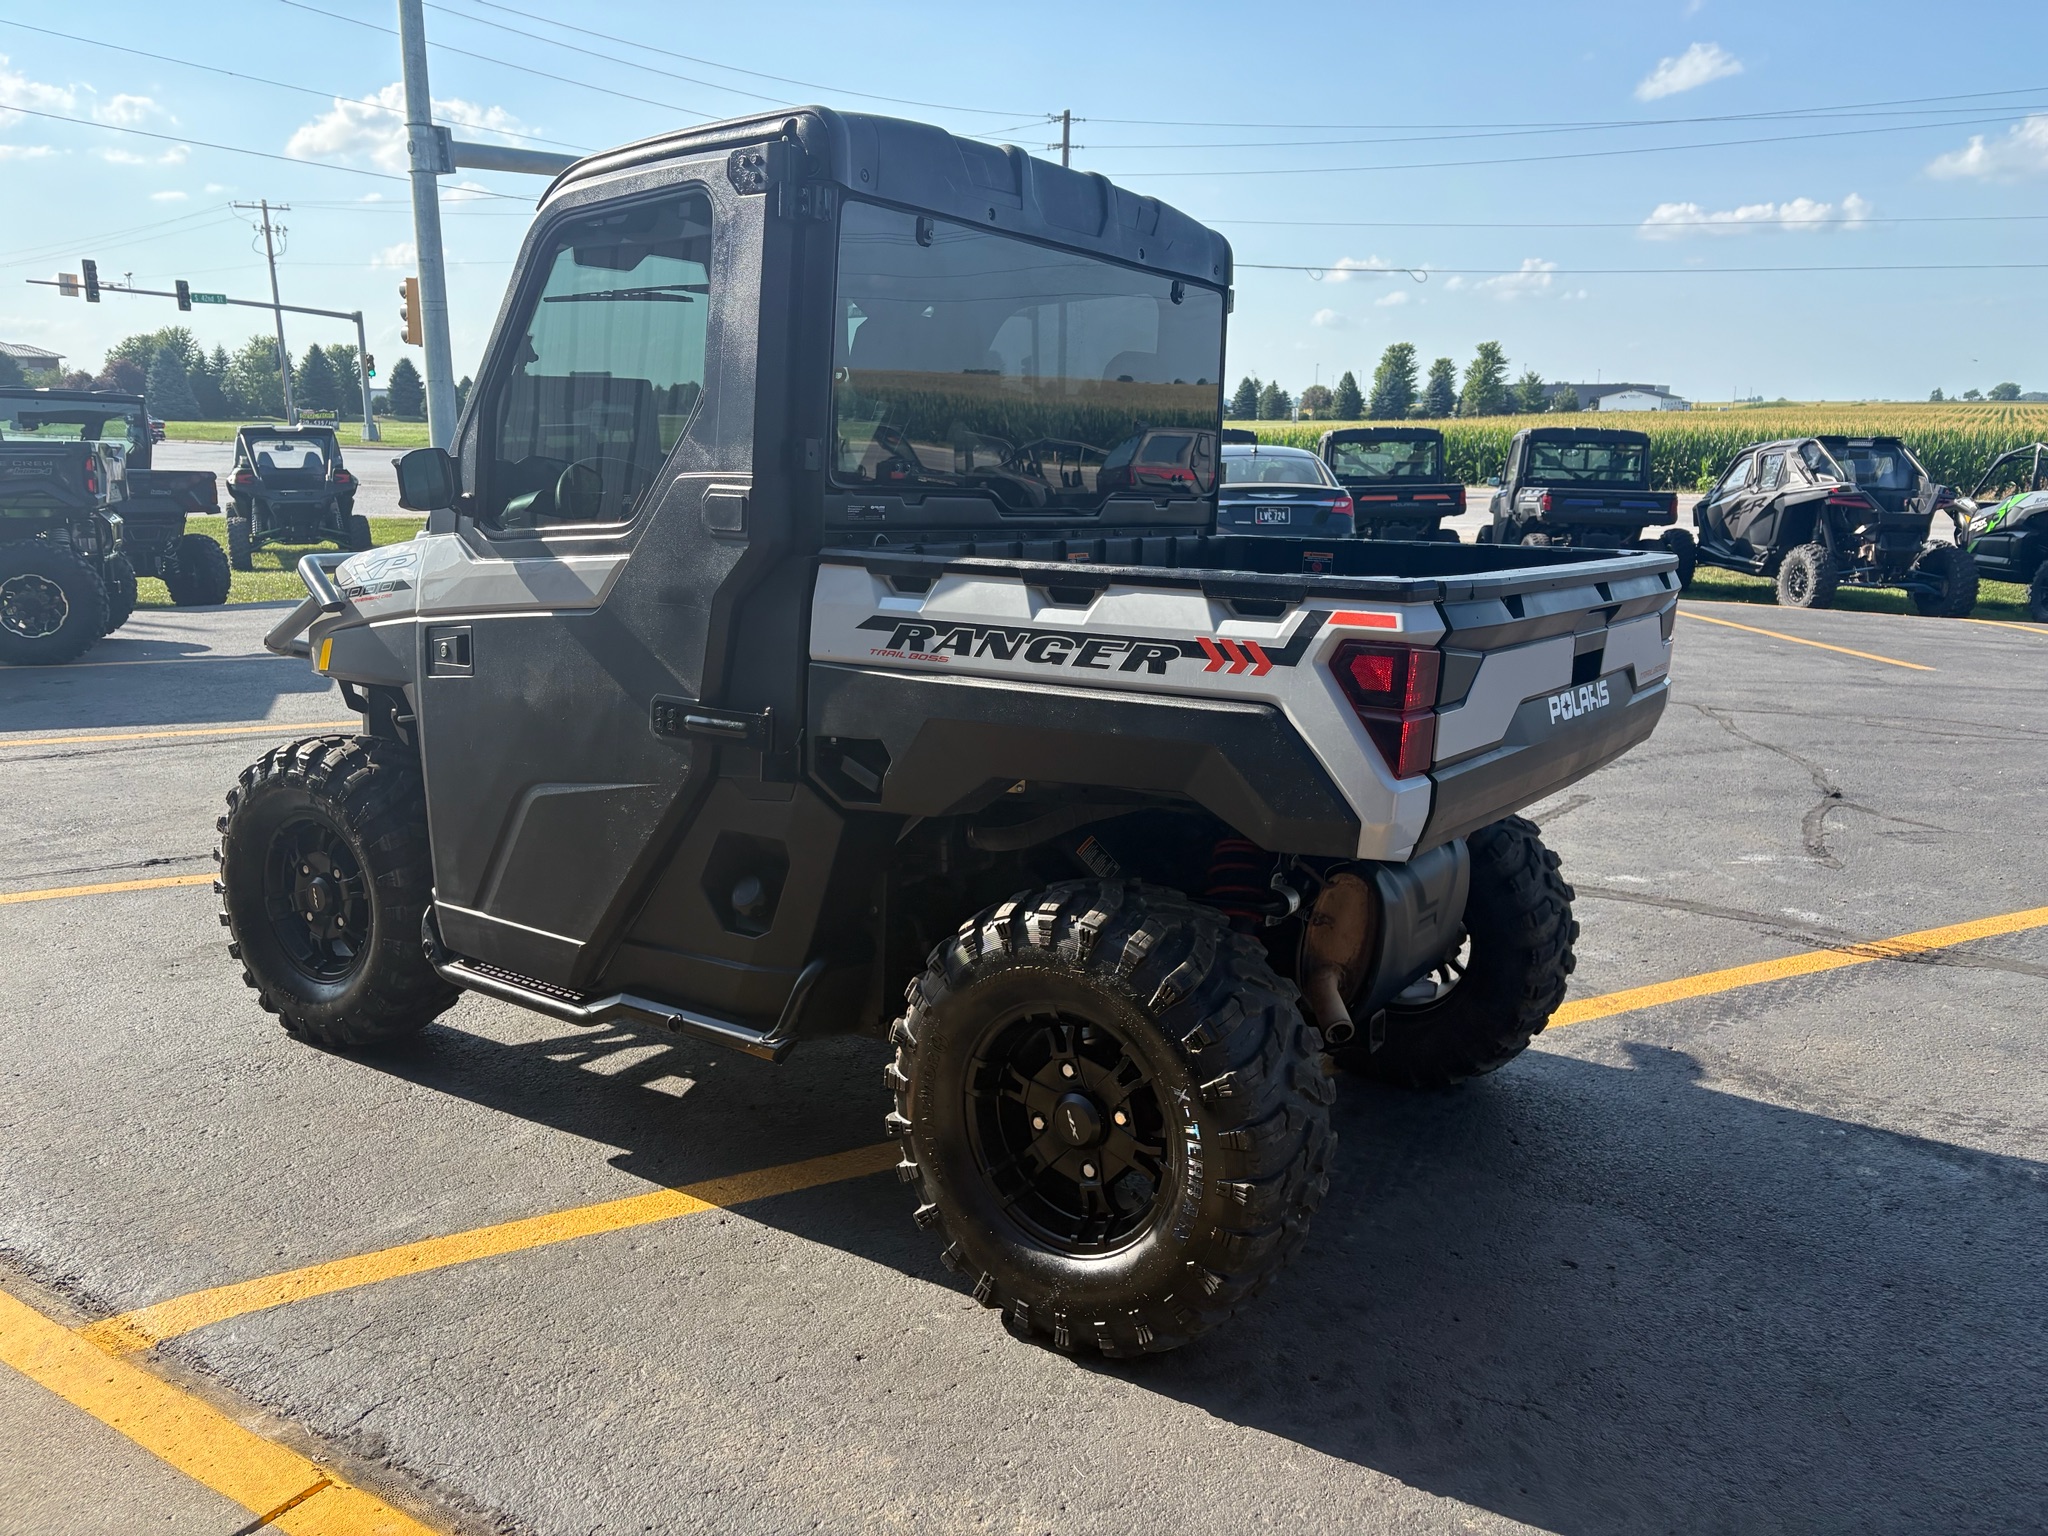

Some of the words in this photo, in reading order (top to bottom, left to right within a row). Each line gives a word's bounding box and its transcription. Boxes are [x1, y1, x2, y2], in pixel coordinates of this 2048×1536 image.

[201, 294, 215, 303] 42nd
[216, 295, 224, 303] St
[1259, 511, 1273, 521] LVC
[1274, 511, 1286, 521] 724
[354, 553, 418, 583] XP
[870, 648, 906, 659] TRAIL
[908, 652, 951, 663] BOSS
[885, 622, 1182, 676] RANGER
[1548, 679, 1610, 725] POLARIS
